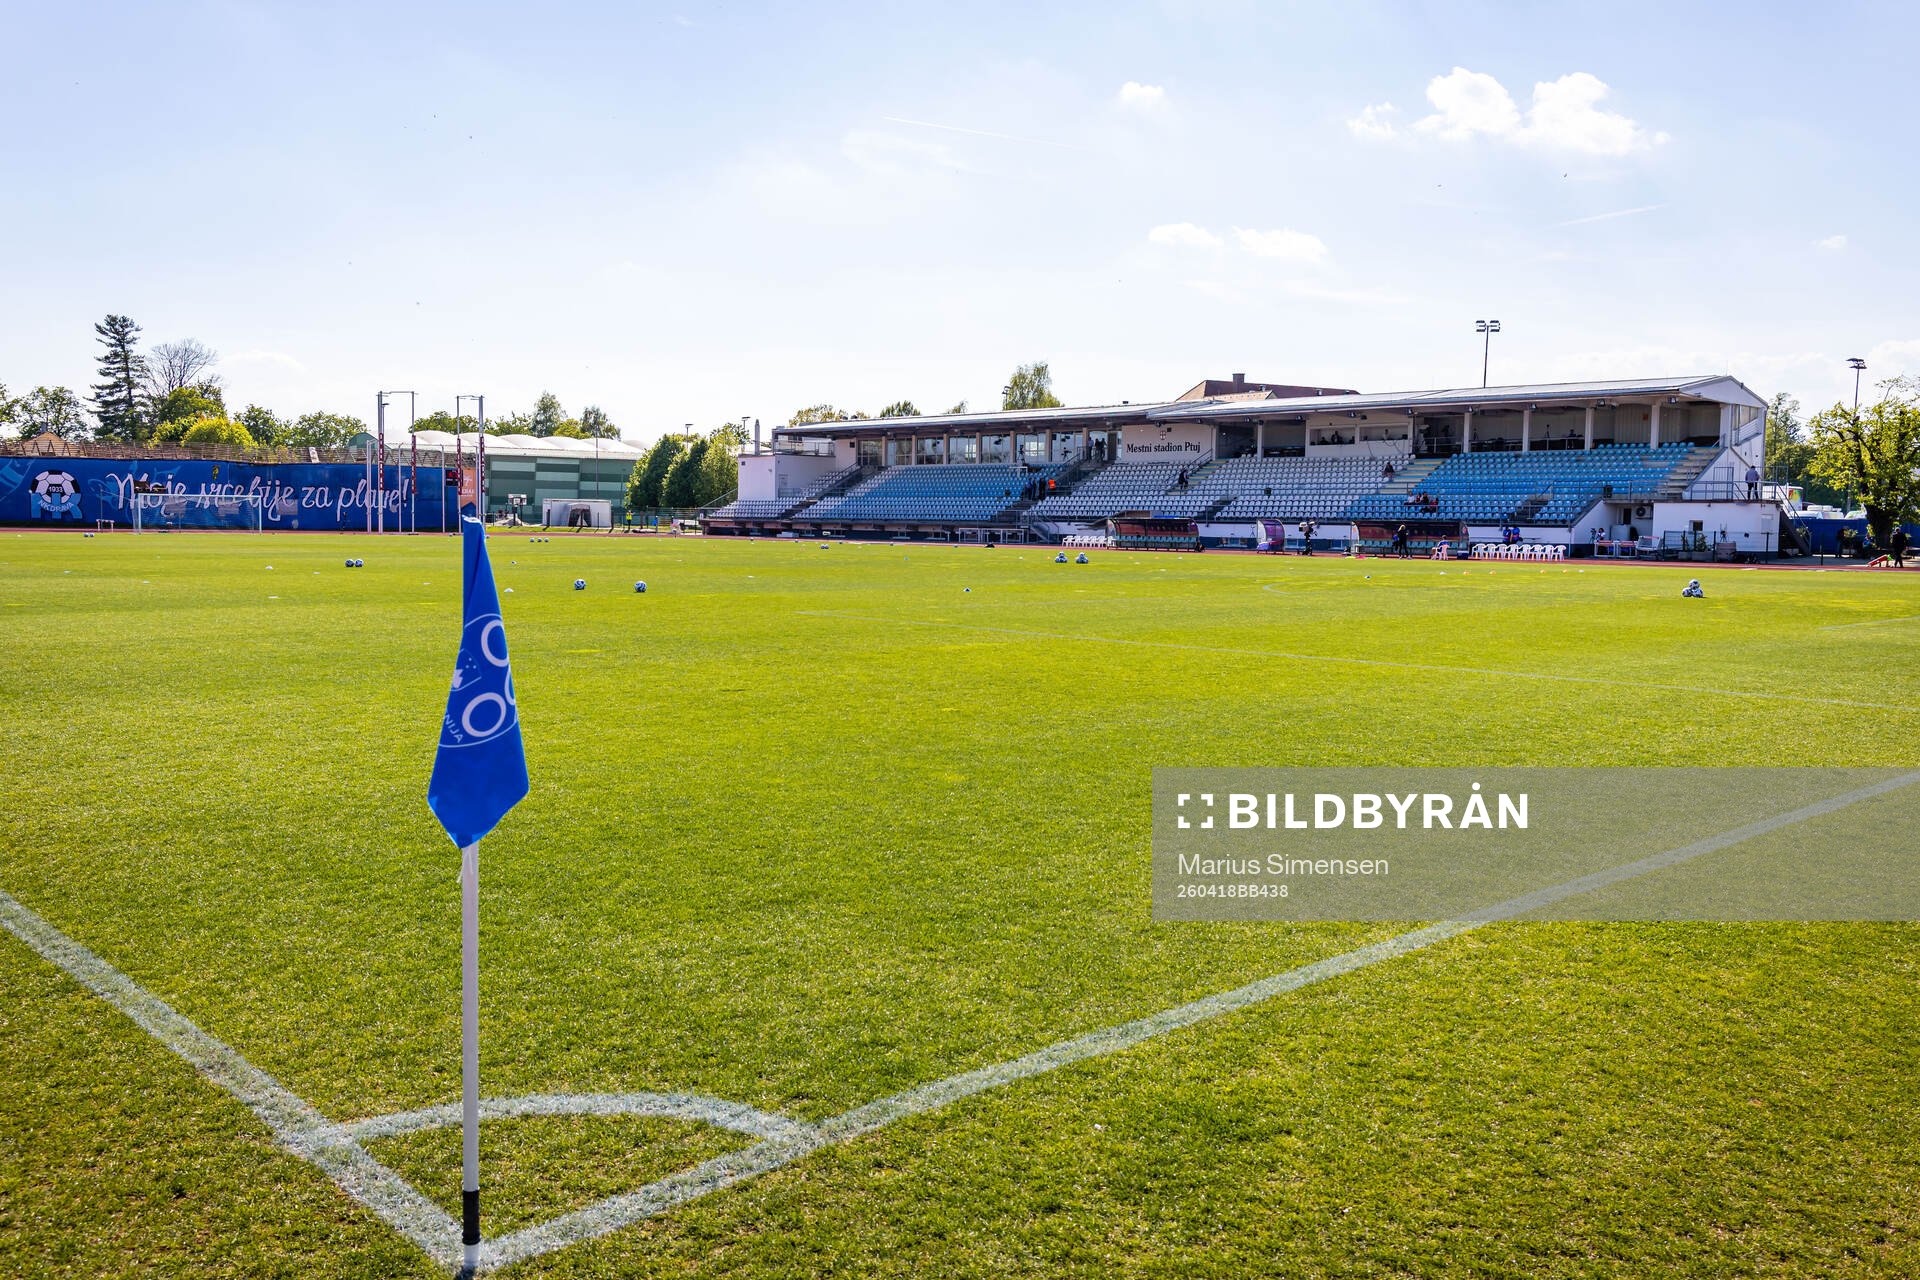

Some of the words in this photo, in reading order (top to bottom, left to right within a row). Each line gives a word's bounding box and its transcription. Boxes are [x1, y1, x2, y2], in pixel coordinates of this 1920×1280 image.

[1126, 443, 1152, 453] Mestni
[1153, 442, 1183, 452] stadion
[1184, 441, 1201, 453] Ptuj
[105, 473, 188, 517] Moje
[301, 486, 333, 508] za
